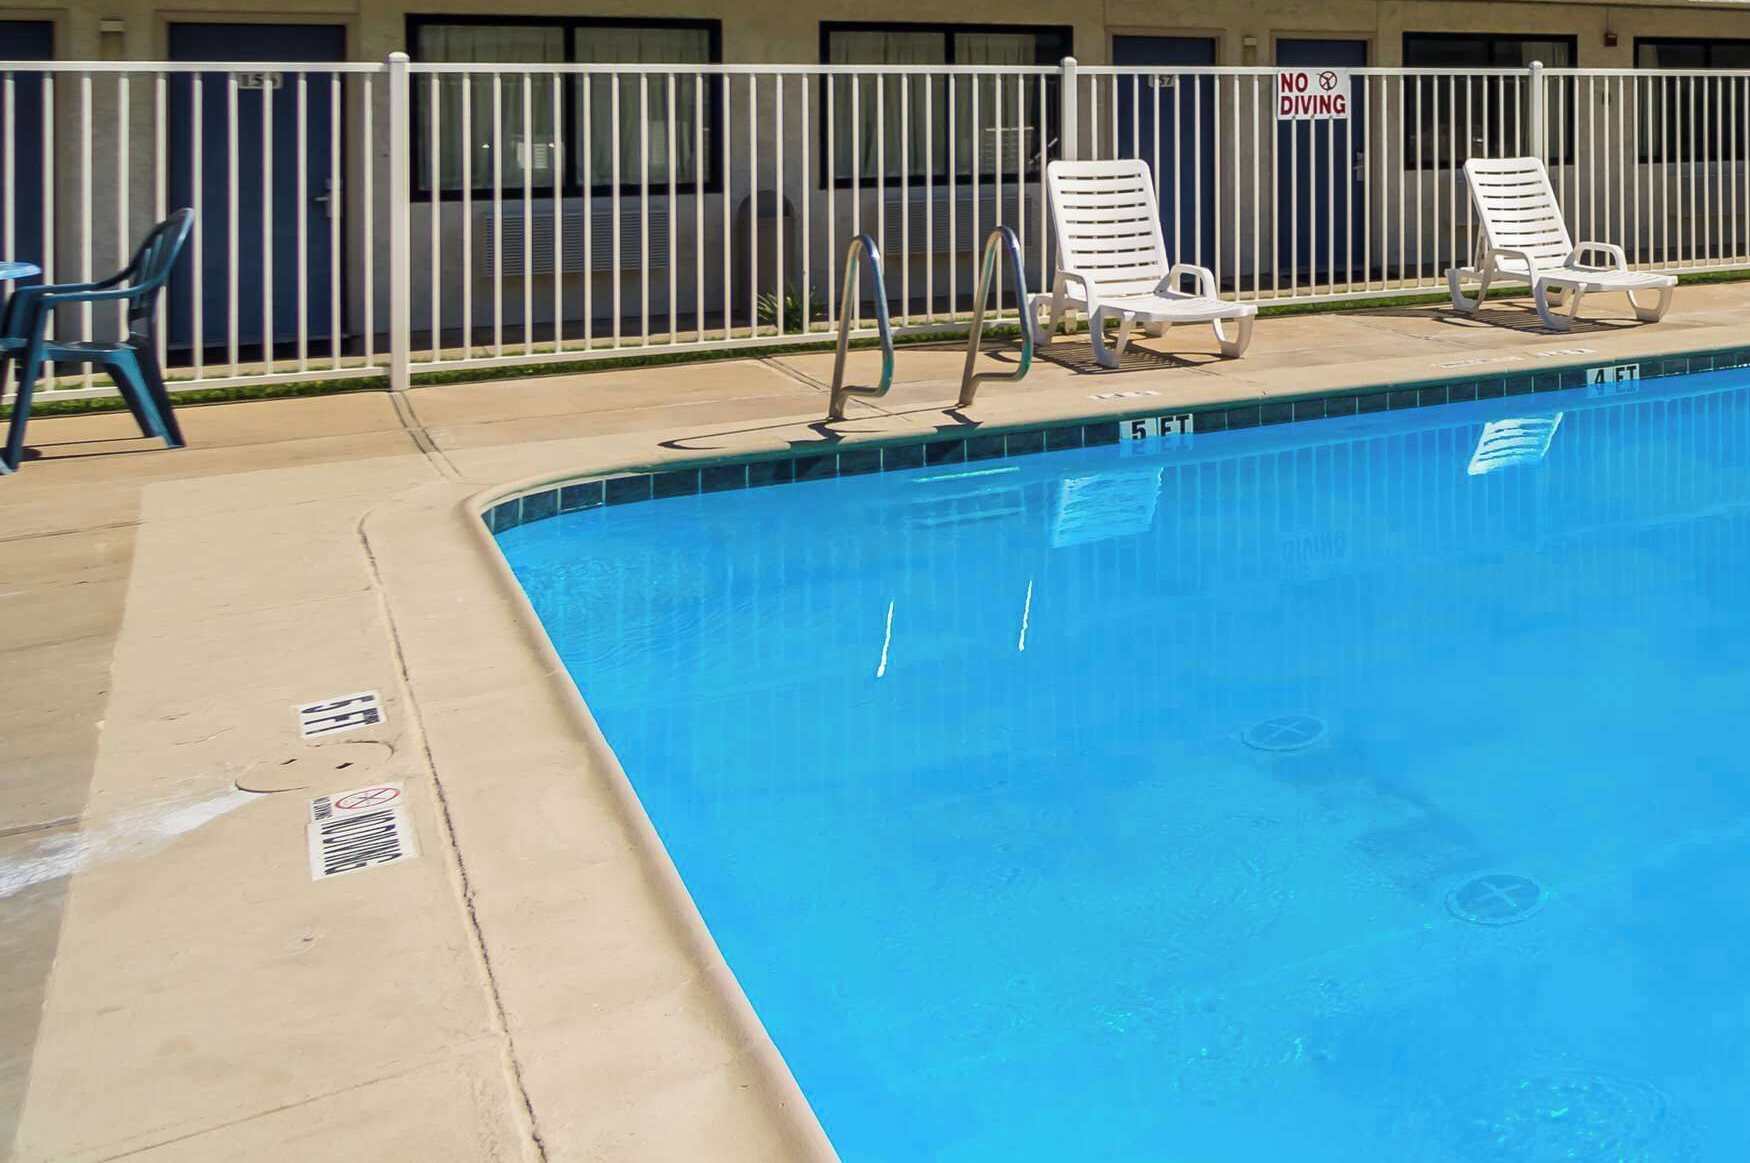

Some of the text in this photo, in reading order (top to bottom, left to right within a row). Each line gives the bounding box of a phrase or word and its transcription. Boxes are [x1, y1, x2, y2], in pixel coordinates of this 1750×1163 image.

[1280, 72, 1309, 93] NO
[1280, 94, 1346, 115] DIVING
[1615, 365, 1637, 382] FT
[1131, 414, 1190, 440] 5 FT
[301, 694, 380, 735] 5 FT
[320, 809, 402, 876] NO DIVING
